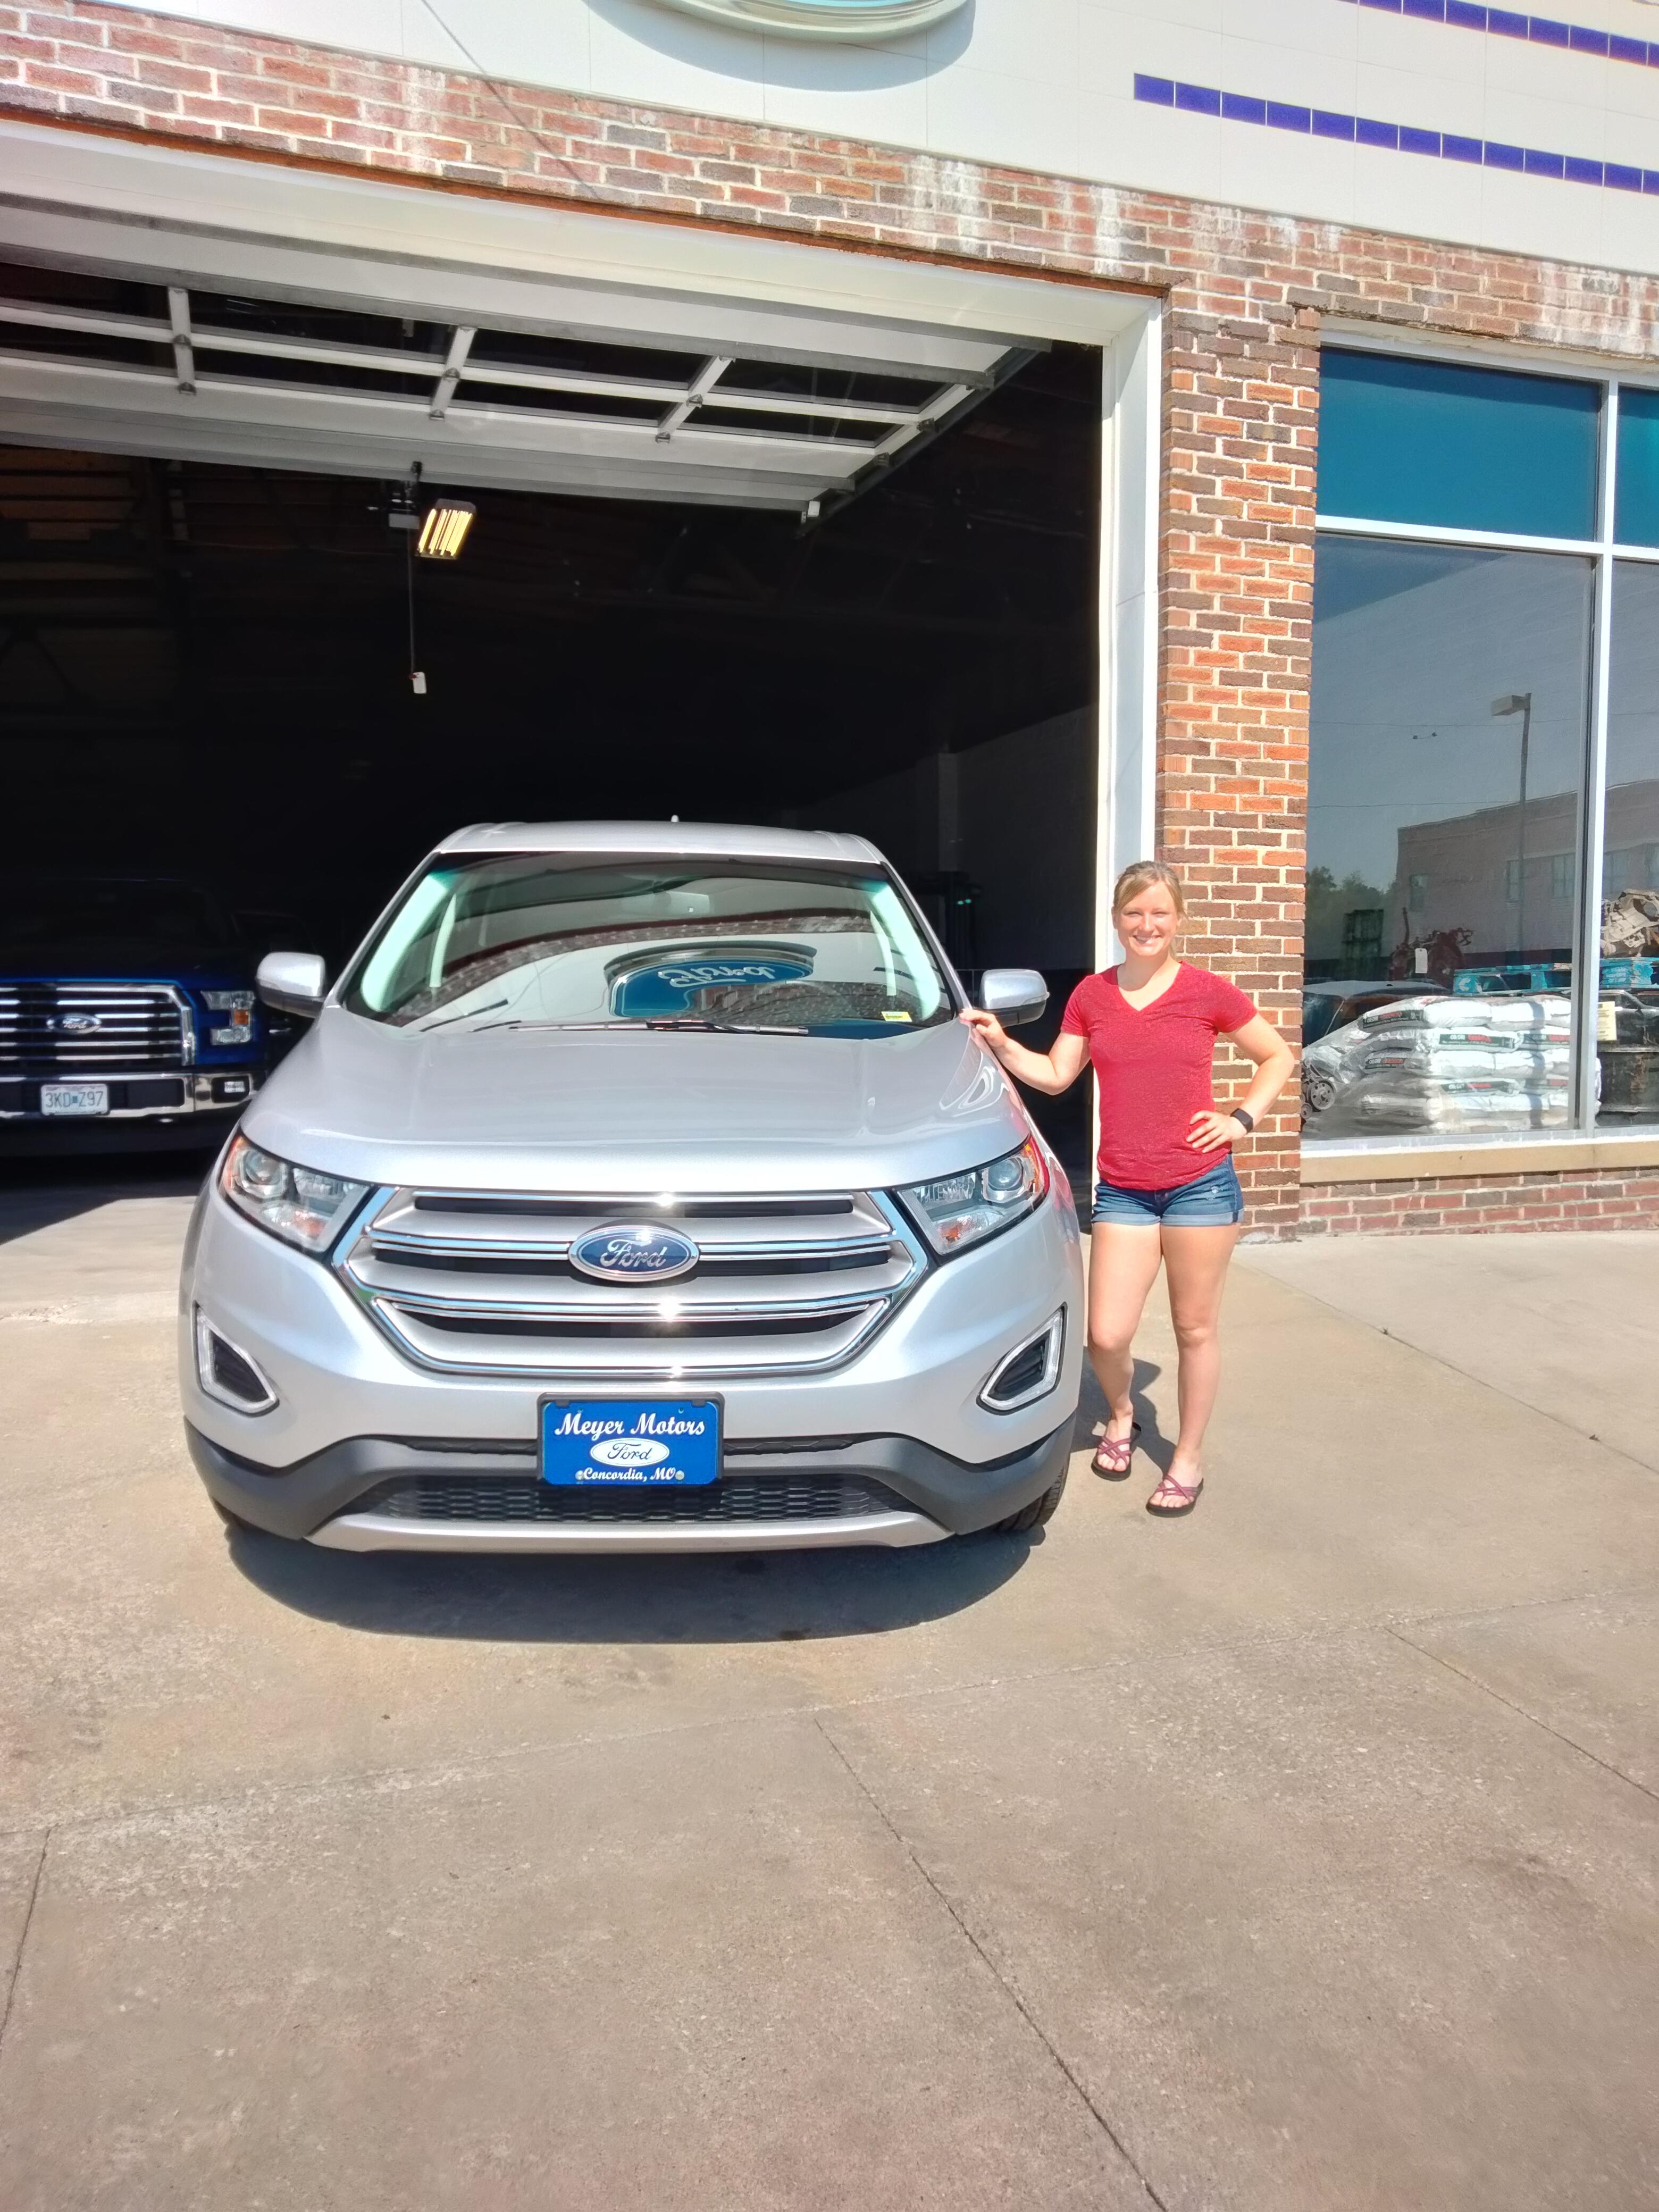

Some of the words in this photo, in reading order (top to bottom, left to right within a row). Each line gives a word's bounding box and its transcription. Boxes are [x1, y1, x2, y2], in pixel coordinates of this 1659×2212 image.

[600, 1238, 667, 1268] Ford
[555, 1412, 625, 1442] Meyer
[631, 1412, 706, 1435] Motors
[607, 1442, 653, 1460] Ford
[583, 1467, 648, 1482] Concordia,
[650, 1467, 676, 1480] MO
